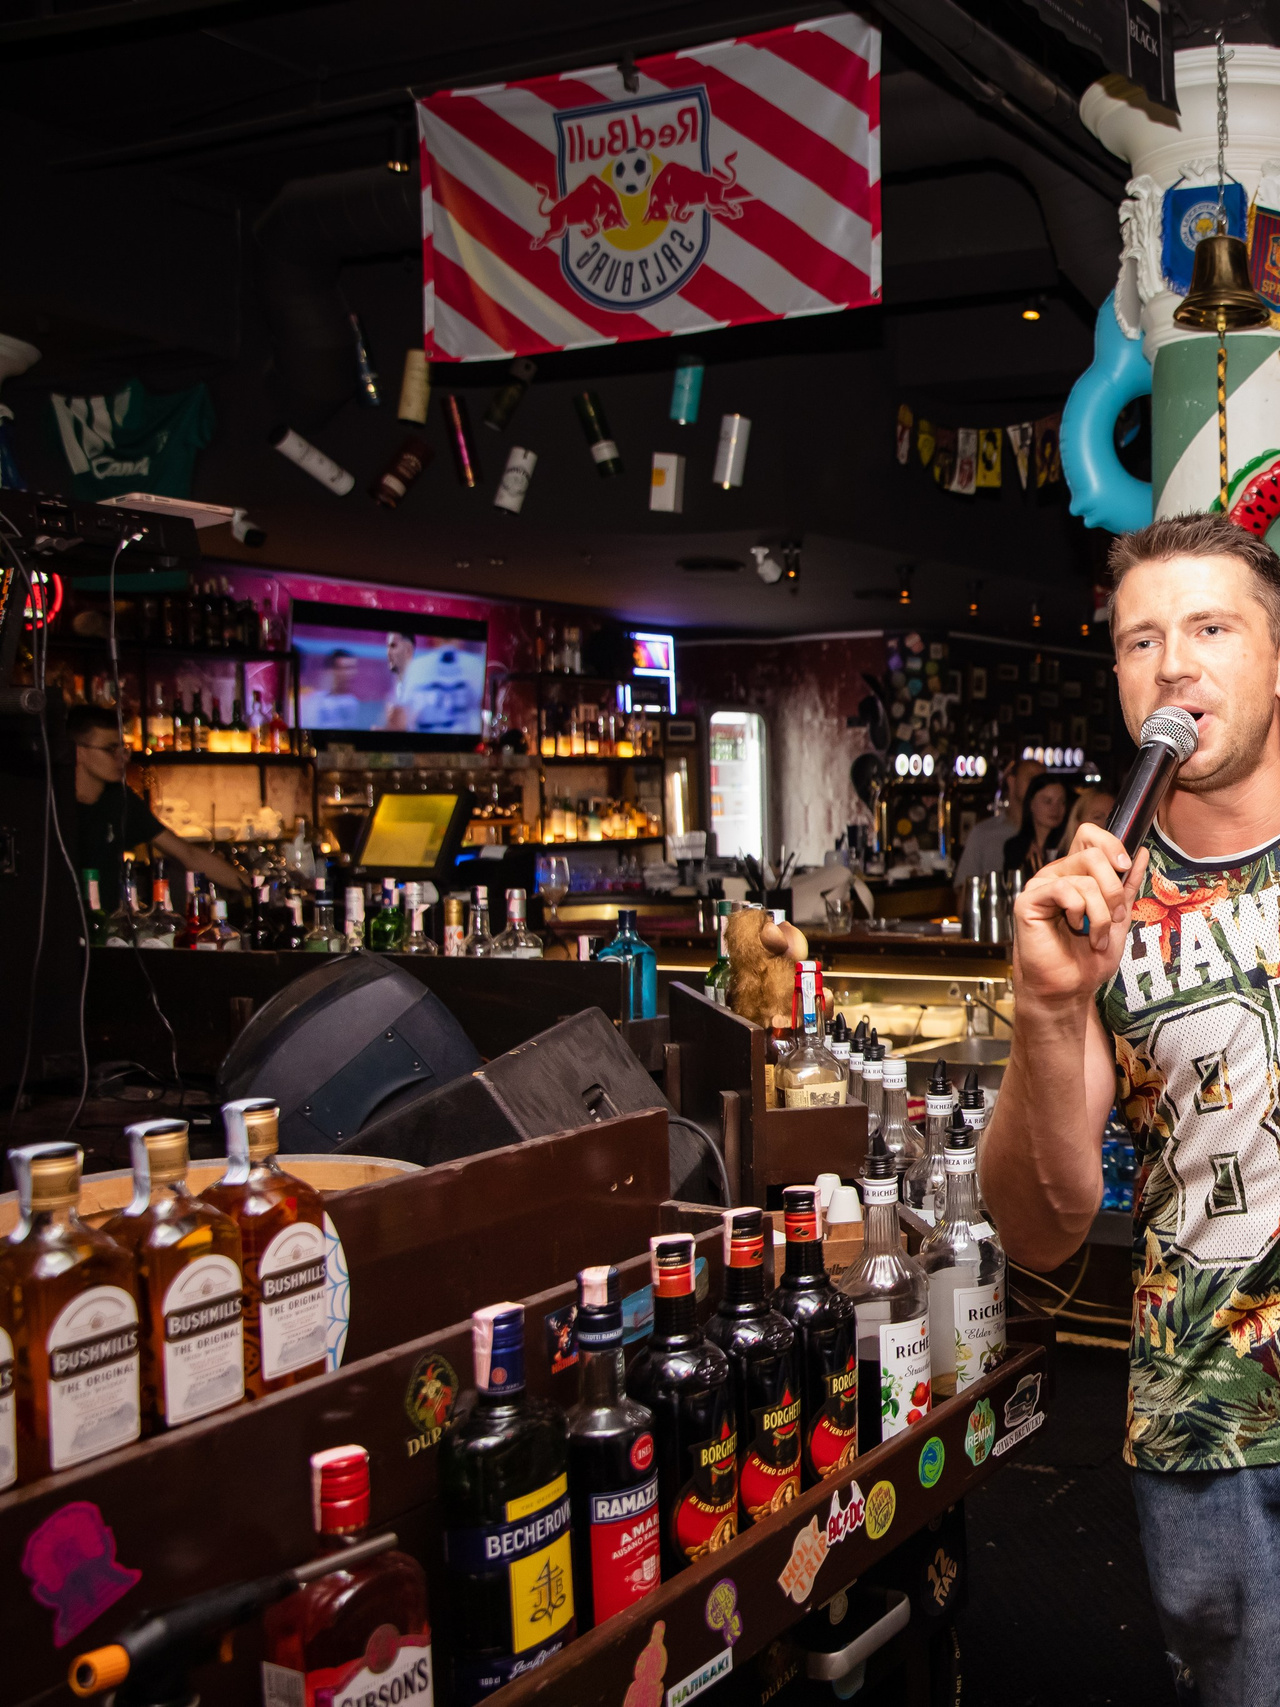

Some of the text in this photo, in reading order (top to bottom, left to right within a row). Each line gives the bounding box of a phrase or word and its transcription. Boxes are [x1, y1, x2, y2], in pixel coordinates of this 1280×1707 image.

[1129, 20, 1159, 57] BLACK
[265, 1263, 326, 1297] BUSHMILLS
[169, 1297, 242, 1335] BUSHMILLS
[268, 1290, 325, 1316] THE ORIGINAL
[55, 1330, 139, 1373] BUSHMILLS
[174, 1325, 240, 1356] THE ORIGINAL
[59, 1362, 135, 1396] THE ORIGINAL
[828, 1426, 843, 1437] VERO
[996, 1434, 1014, 1453] JAWS
[1014, 1415, 1041, 1439] BREWERY
[637, 1444, 652, 1460] 1815
[760, 1463, 777, 1476] VERO
[688, 1495, 698, 1506] DI
[697, 1501, 715, 1513] VERO
[828, 1498, 865, 1543] AC/DC
[793, 1534, 827, 1592] TRIP
